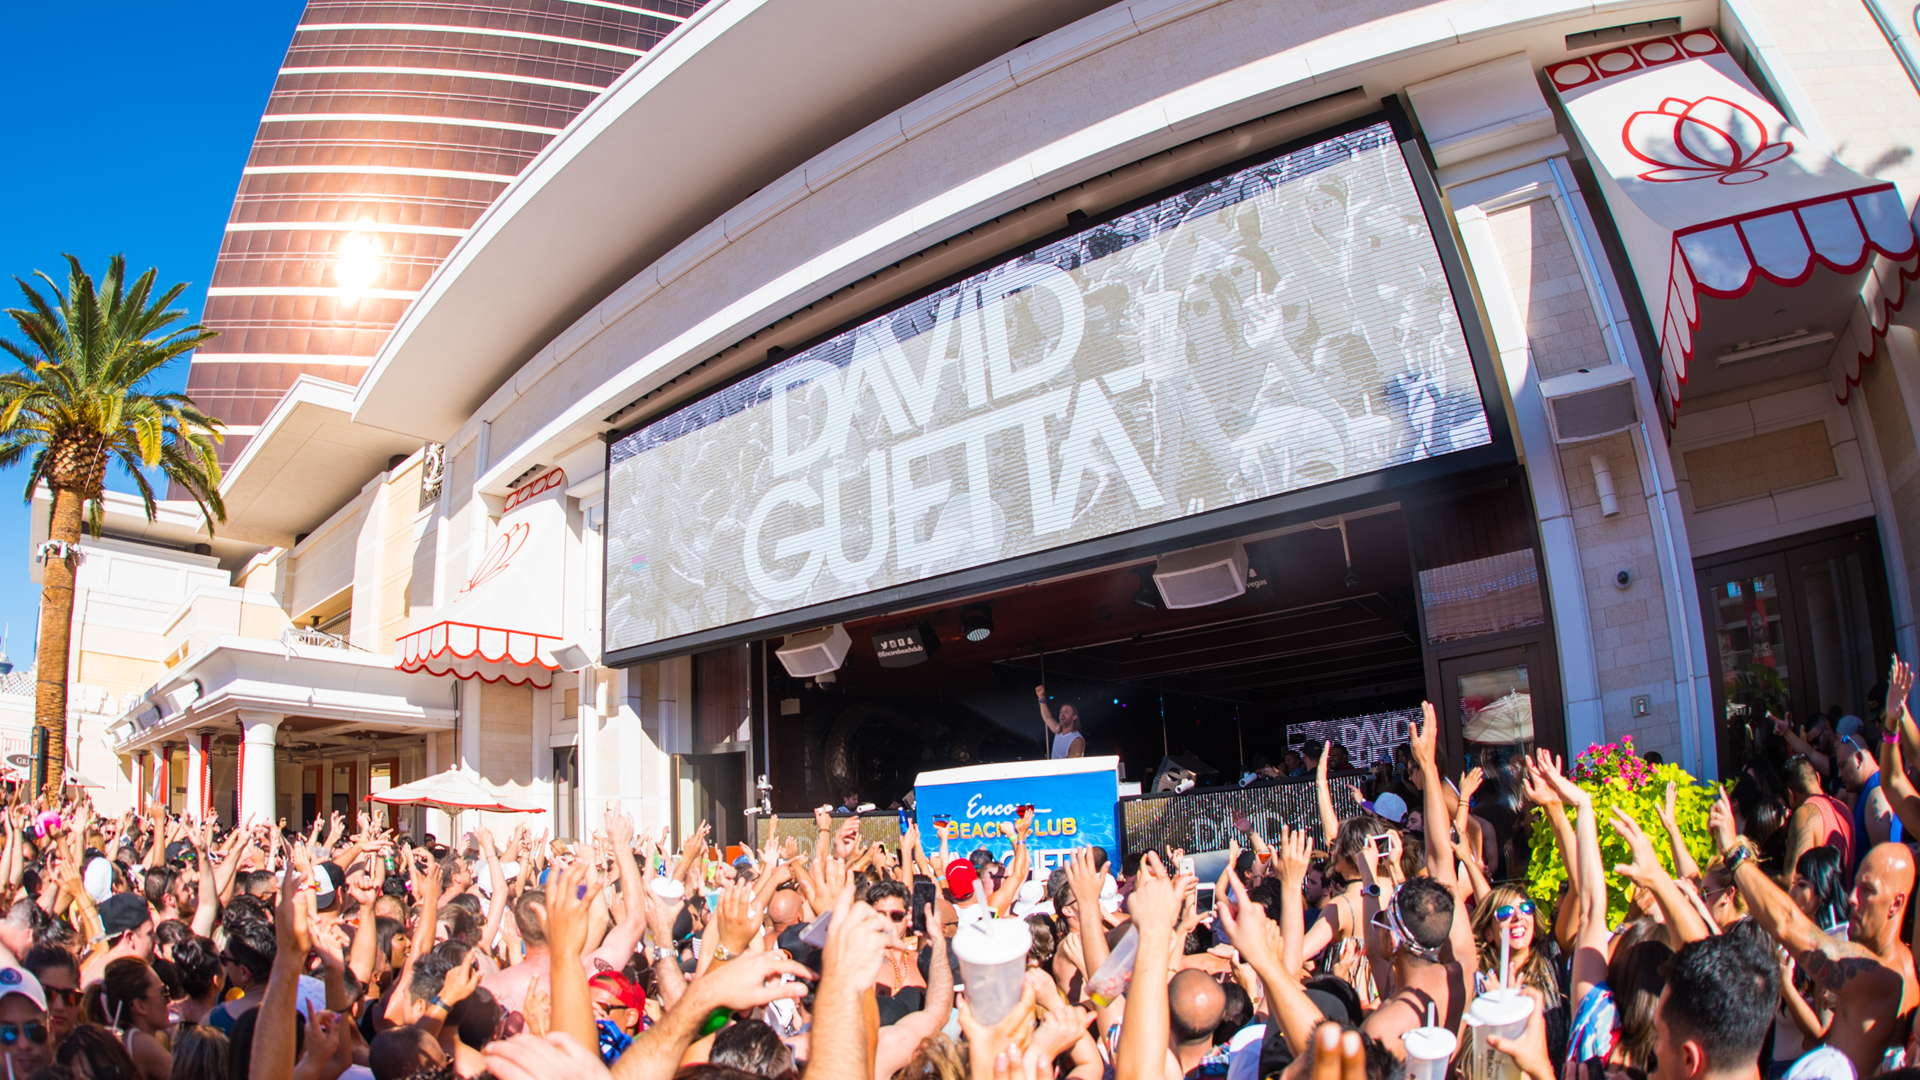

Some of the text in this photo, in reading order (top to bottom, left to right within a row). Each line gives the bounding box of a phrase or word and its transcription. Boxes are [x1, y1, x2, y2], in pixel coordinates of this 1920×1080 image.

[766, 262, 1085, 477] DAVID
[743, 364, 1166, 601] GUETTA
[1338, 716, 1411, 748] DAVID
[966, 793, 1053, 819] Enco
[1017, 817, 1077, 837] LUB
